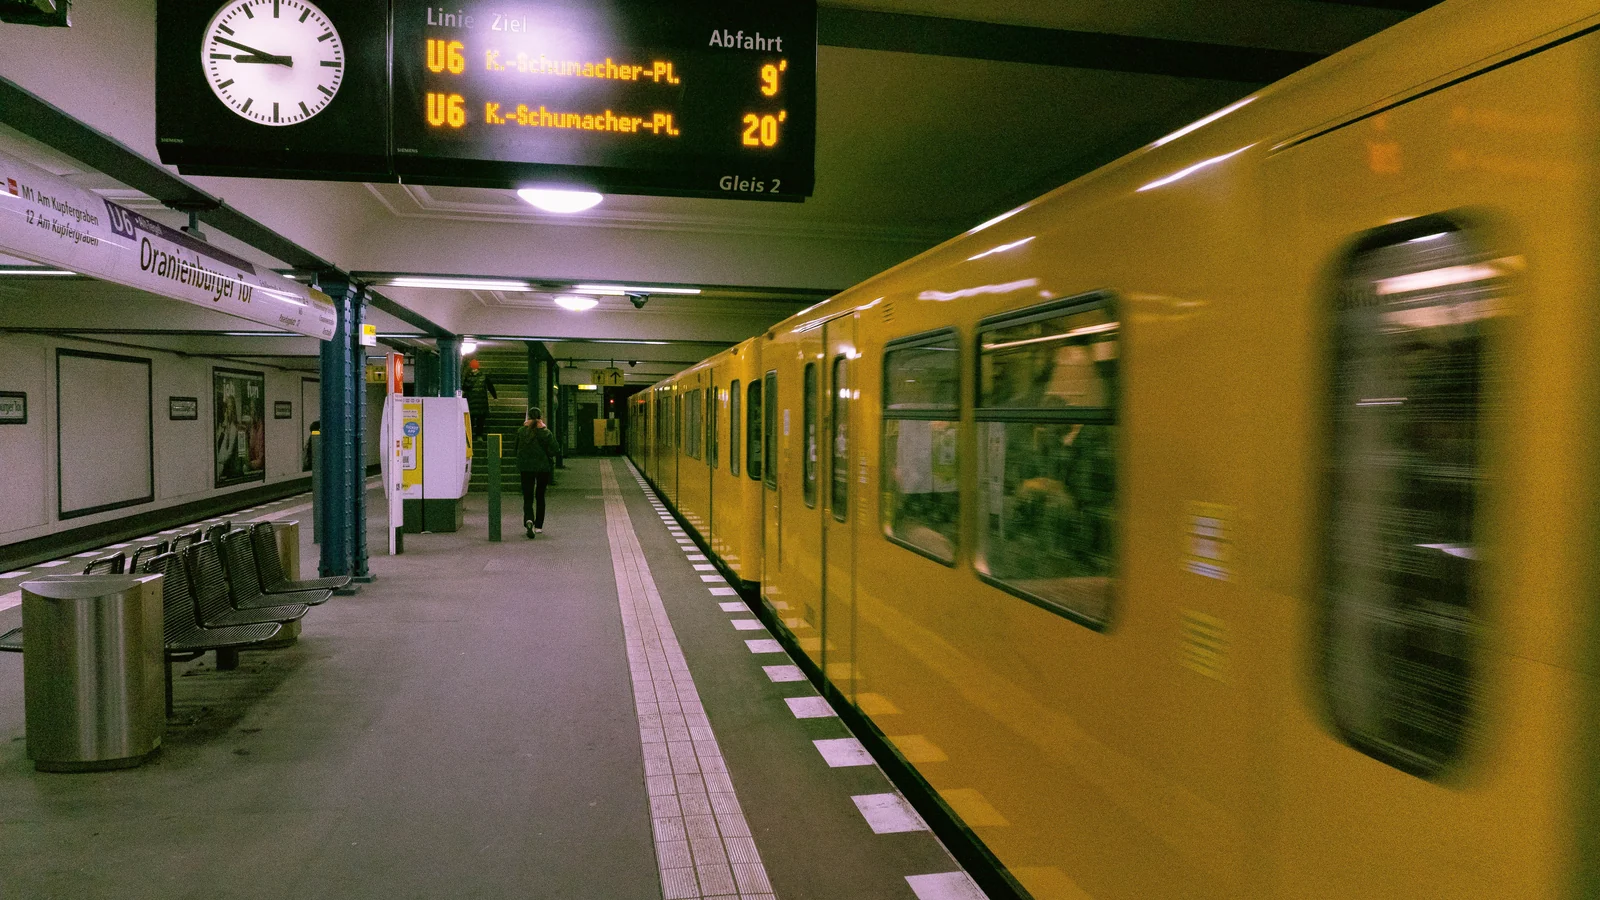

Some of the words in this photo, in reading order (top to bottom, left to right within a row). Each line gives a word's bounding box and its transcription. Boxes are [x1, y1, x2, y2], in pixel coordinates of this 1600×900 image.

[427, 7, 475, 29] Linie
[491, 12, 527, 33] Ziel
[709, 29, 783, 52] Abfahrt
[427, 39, 465, 74] U6
[485, 49, 680, 84] K.-Schumacher-Pl.
[427, 93, 465, 127] U6
[485, 102, 679, 136] K.-Schumacher-Pl.
[743, 110, 786, 147] 20'
[719, 175, 765, 193] Gleis
[769, 178, 781, 193] 2
[21, 184, 35, 202] M1
[37, 190, 51, 208] Am
[51, 196, 99, 226] Kupfergraben
[107, 203, 134, 236] U6
[26, 209, 35, 225] 12
[37, 213, 51, 231] Am
[52, 218, 99, 247] Kupfergraben
[140, 236, 235, 302] Oranienburger
[237, 272, 254, 304] Tor
